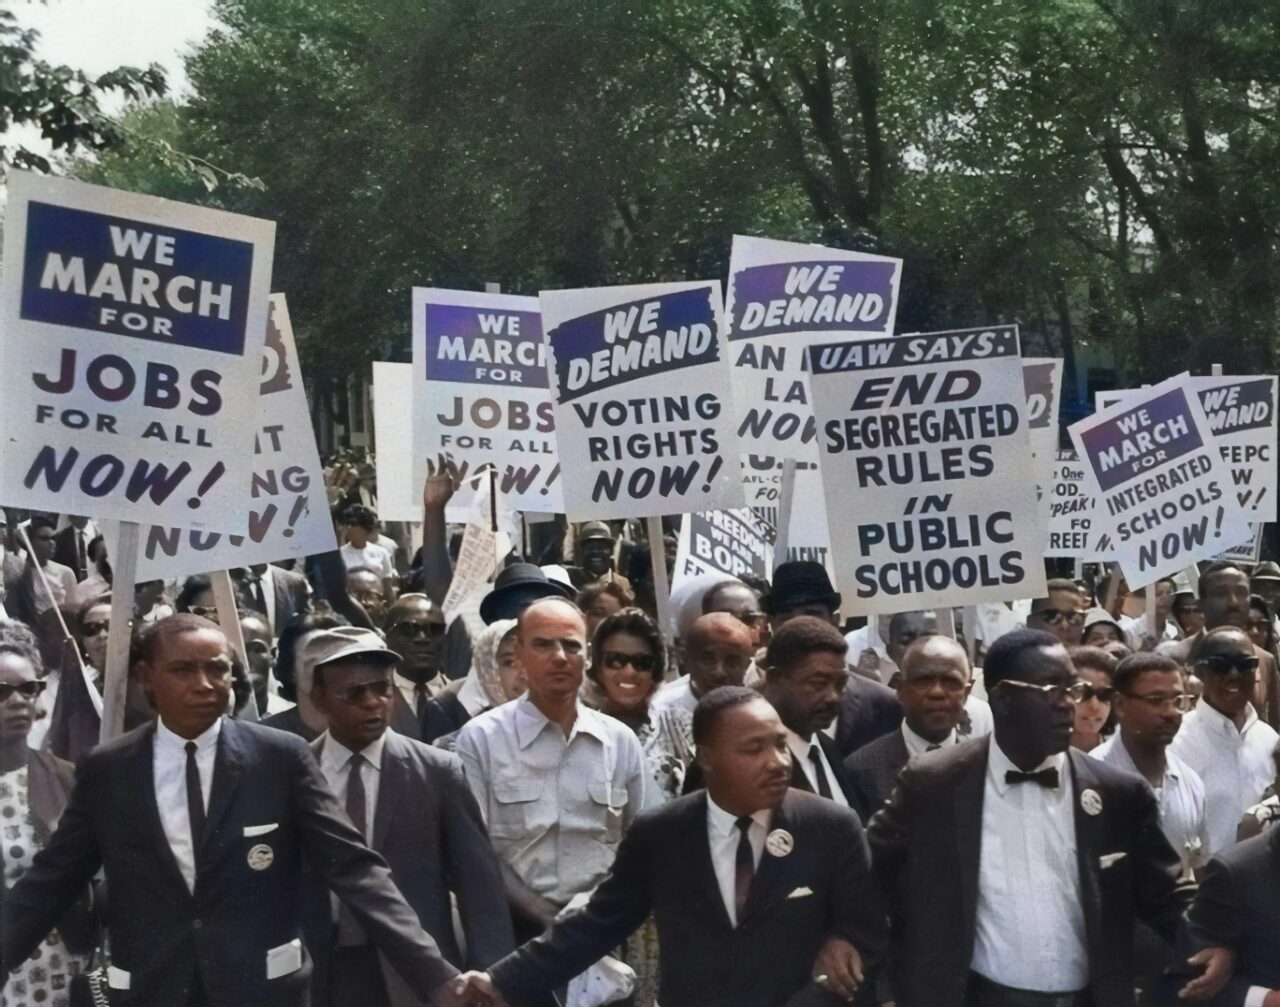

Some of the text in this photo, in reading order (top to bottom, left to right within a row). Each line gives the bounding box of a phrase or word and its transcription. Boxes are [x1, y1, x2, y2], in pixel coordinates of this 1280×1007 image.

[109, 225, 176, 266] WE
[39, 252, 233, 321] MARCH
[783, 264, 845, 296] WE
[100, 308, 174, 337] FOR
[477, 313, 520, 337] WE
[603, 301, 661, 344] WE
[739, 292, 884, 332] DEMAND
[566, 323, 713, 391] DEMAND
[735, 343, 786, 371] AN
[819, 342, 896, 370] UAW
[903, 330, 1011, 362] SAYS:
[32, 348, 224, 417] JOBS
[475, 368, 522, 383] FOR
[764, 377, 808, 404] LA
[850, 370, 982, 411] END
[436, 397, 555, 432] JOBS
[572, 392, 721, 428] VOTING
[1204, 386, 1240, 412] WE
[1208, 401, 1268, 430] MAND
[35, 405, 213, 448] FOR ALL
[825, 403, 1019, 454] SEGREGATED
[1117, 409, 1151, 435] WE
[440, 434, 553, 455] FOR ALL
[588, 428, 719, 463] RIGHTS
[1098, 414, 1188, 472] MARCH
[1131, 450, 1167, 472] FOR
[23, 445, 226, 509] NOW!
[591, 455, 724, 503] NOW!
[856, 444, 994, 488] RULES
[1106, 454, 1212, 516] INTEGRATED
[755, 487, 779, 500] FO
[903, 493, 953, 516] IN
[1117, 481, 1223, 541] SCHOOLS
[857, 511, 1014, 557] PUBLIC
[1139, 505, 1224, 572] NOW!
[854, 550, 1025, 599] SCHOOLS
